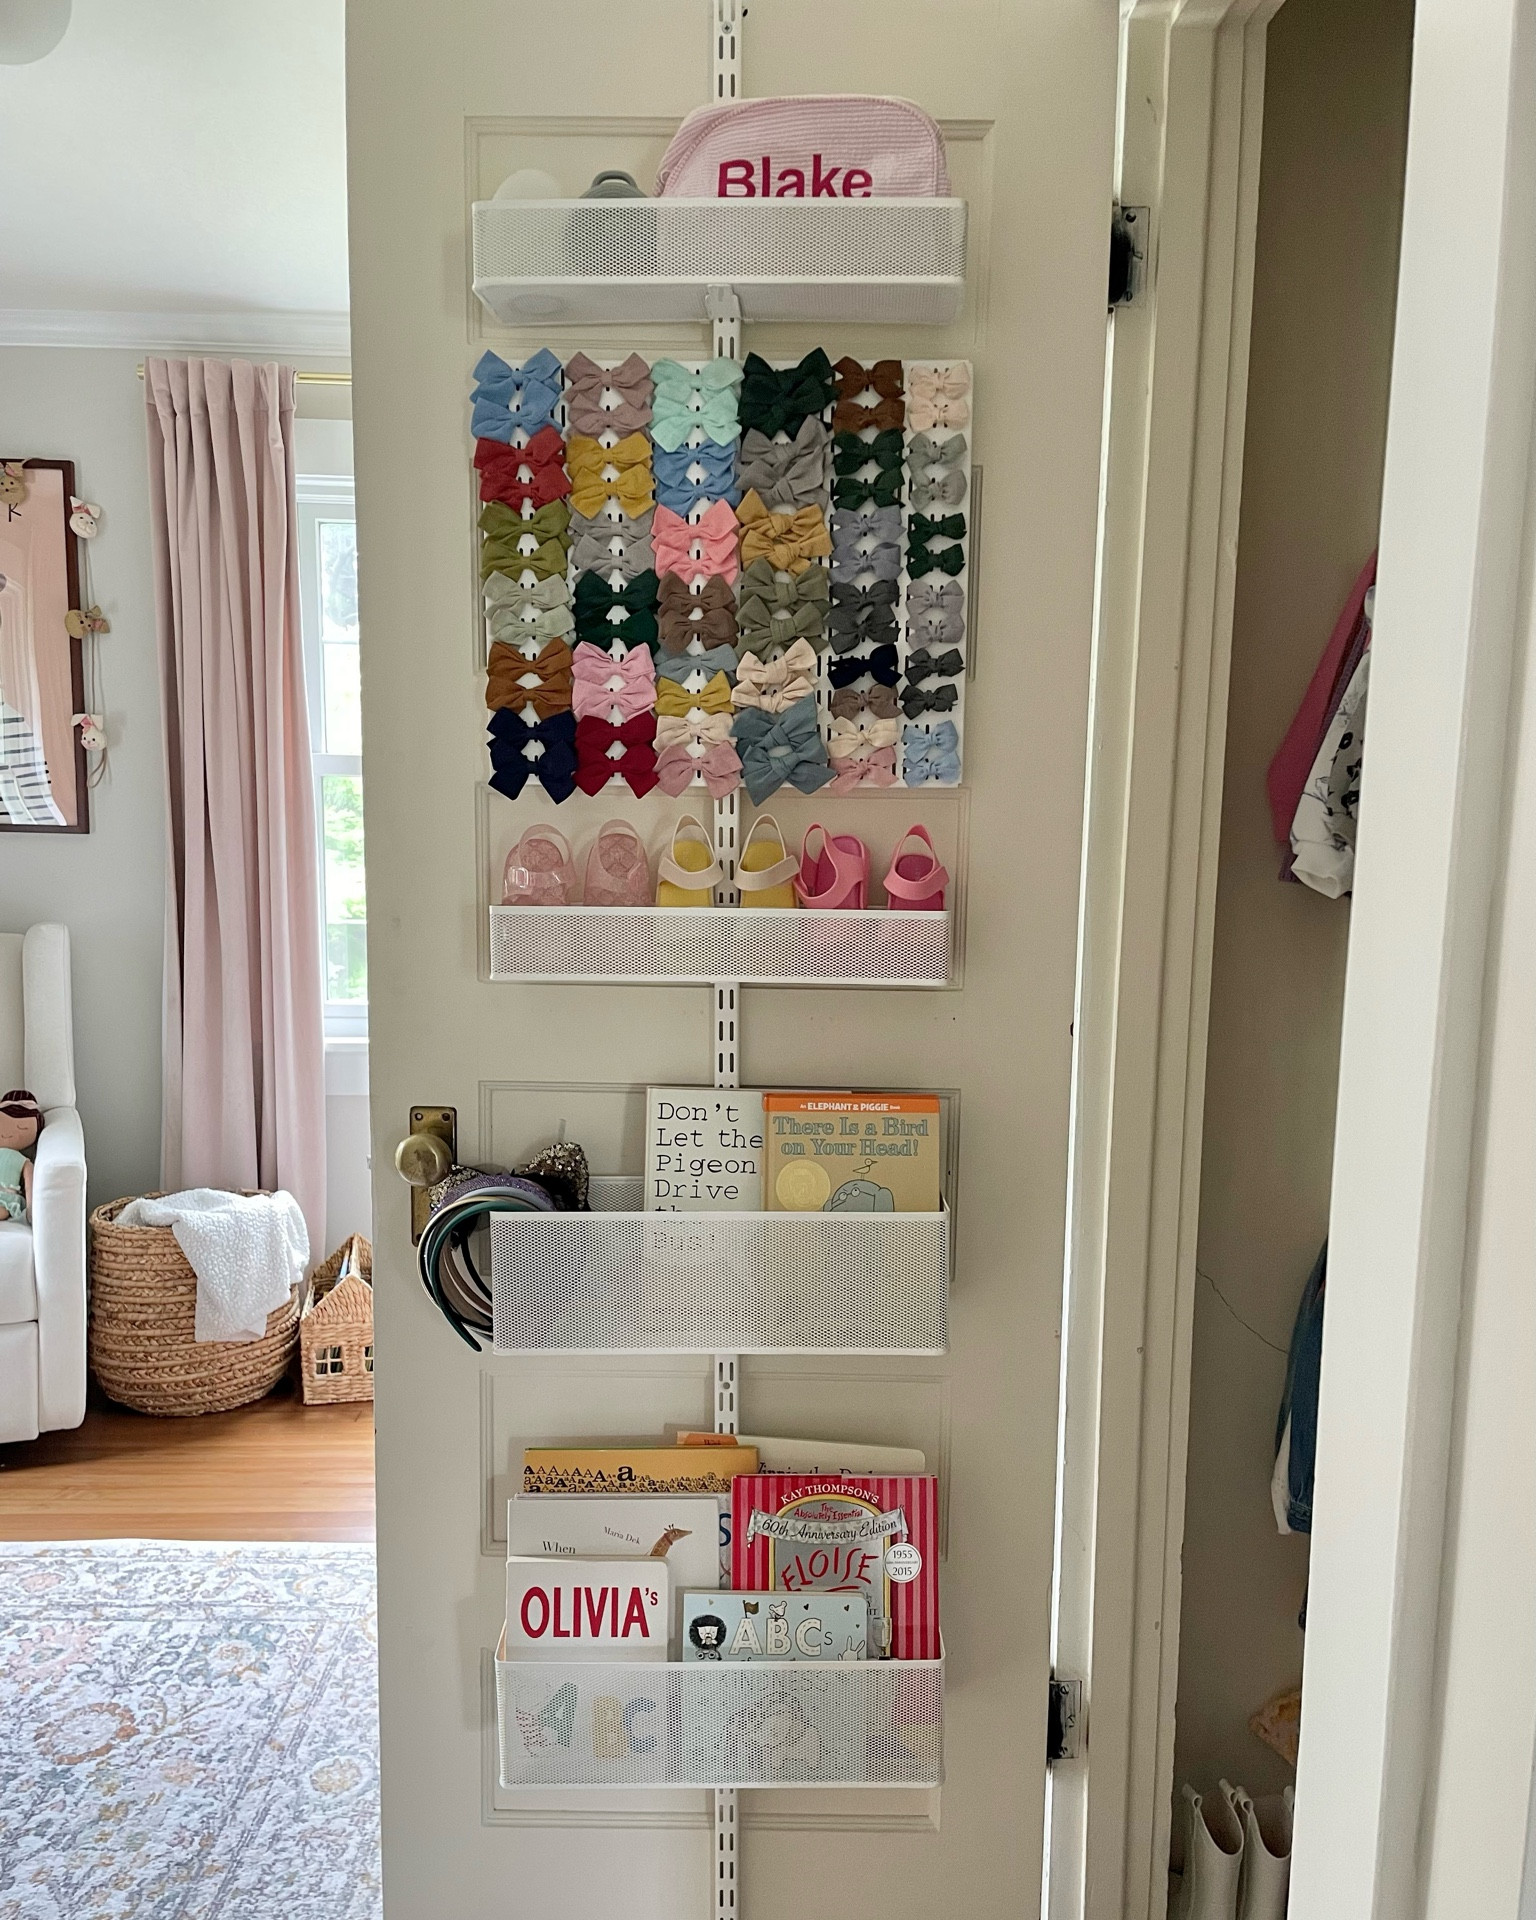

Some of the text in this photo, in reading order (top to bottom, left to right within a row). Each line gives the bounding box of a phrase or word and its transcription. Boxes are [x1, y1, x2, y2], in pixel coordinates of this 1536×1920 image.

[718, 154, 873, 198] Blake
[657, 1102, 740, 1122] Don't
[807, 1102, 852, 1111] ELEPHANT
[852, 1103, 859, 1111] &
[860, 1103, 889, 1111] PIGGIE
[773, 1116, 929, 1137] There Is a Bird
[656, 1128, 763, 1148] Let the
[780, 1138, 919, 1156] on Your Head!
[656, 1152, 757, 1177] Pigeon
[654, 1179, 739, 1200] Drive
[780, 1483, 879, 1505] KAY THOMPSON'S
[794, 1508, 863, 1521] Absolutely Essential
[604, 1526, 624, 1539] Maria
[762, 1519, 897, 1541] 60th Anniversary Edition
[542, 1540, 576, 1555] When
[893, 1550, 913, 1559] 1955
[781, 1546, 879, 1591] ELOISE
[892, 1566, 912, 1576] 2015
[520, 1586, 658, 1639] OLIVIA's
[728, 1617, 833, 1657] ABCs
